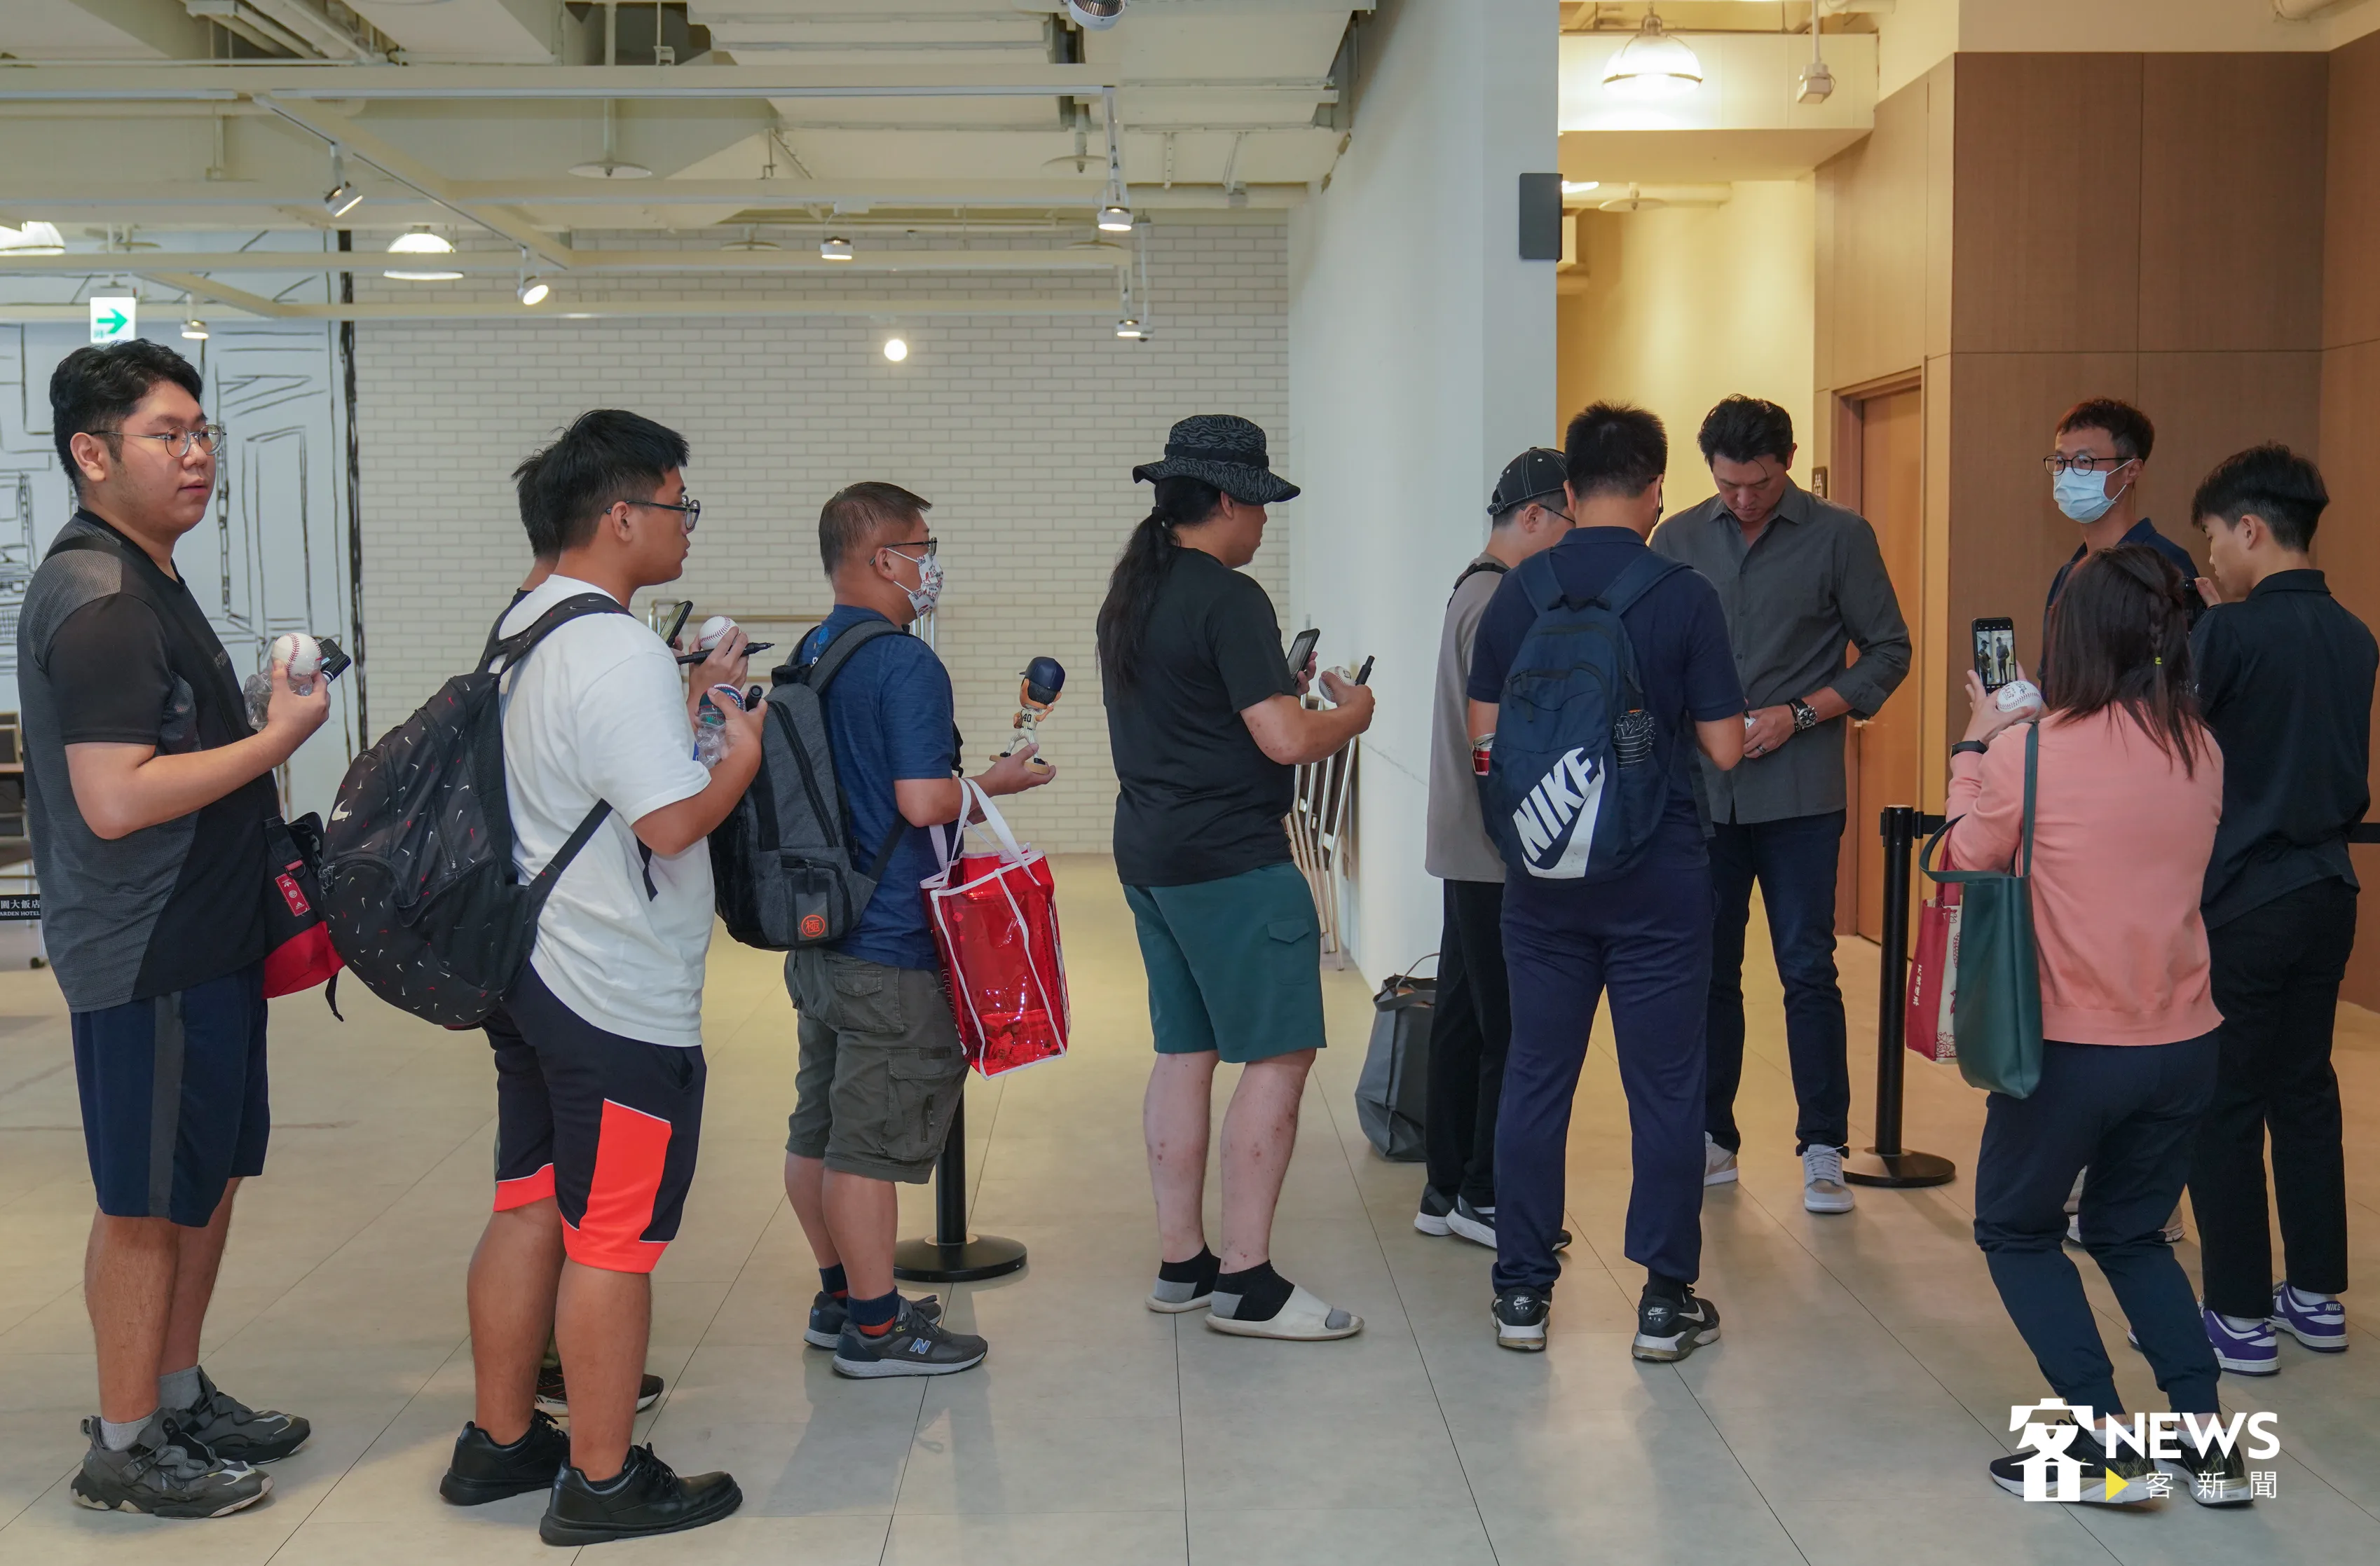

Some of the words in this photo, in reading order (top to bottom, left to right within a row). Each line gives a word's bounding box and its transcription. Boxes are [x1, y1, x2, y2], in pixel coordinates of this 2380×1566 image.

[1023, 713, 1032, 722] 40
[1512, 747, 1595, 863] NIKE
[2325, 1303, 2341, 1312] NIKE
[909, 1337, 931, 1354] N
